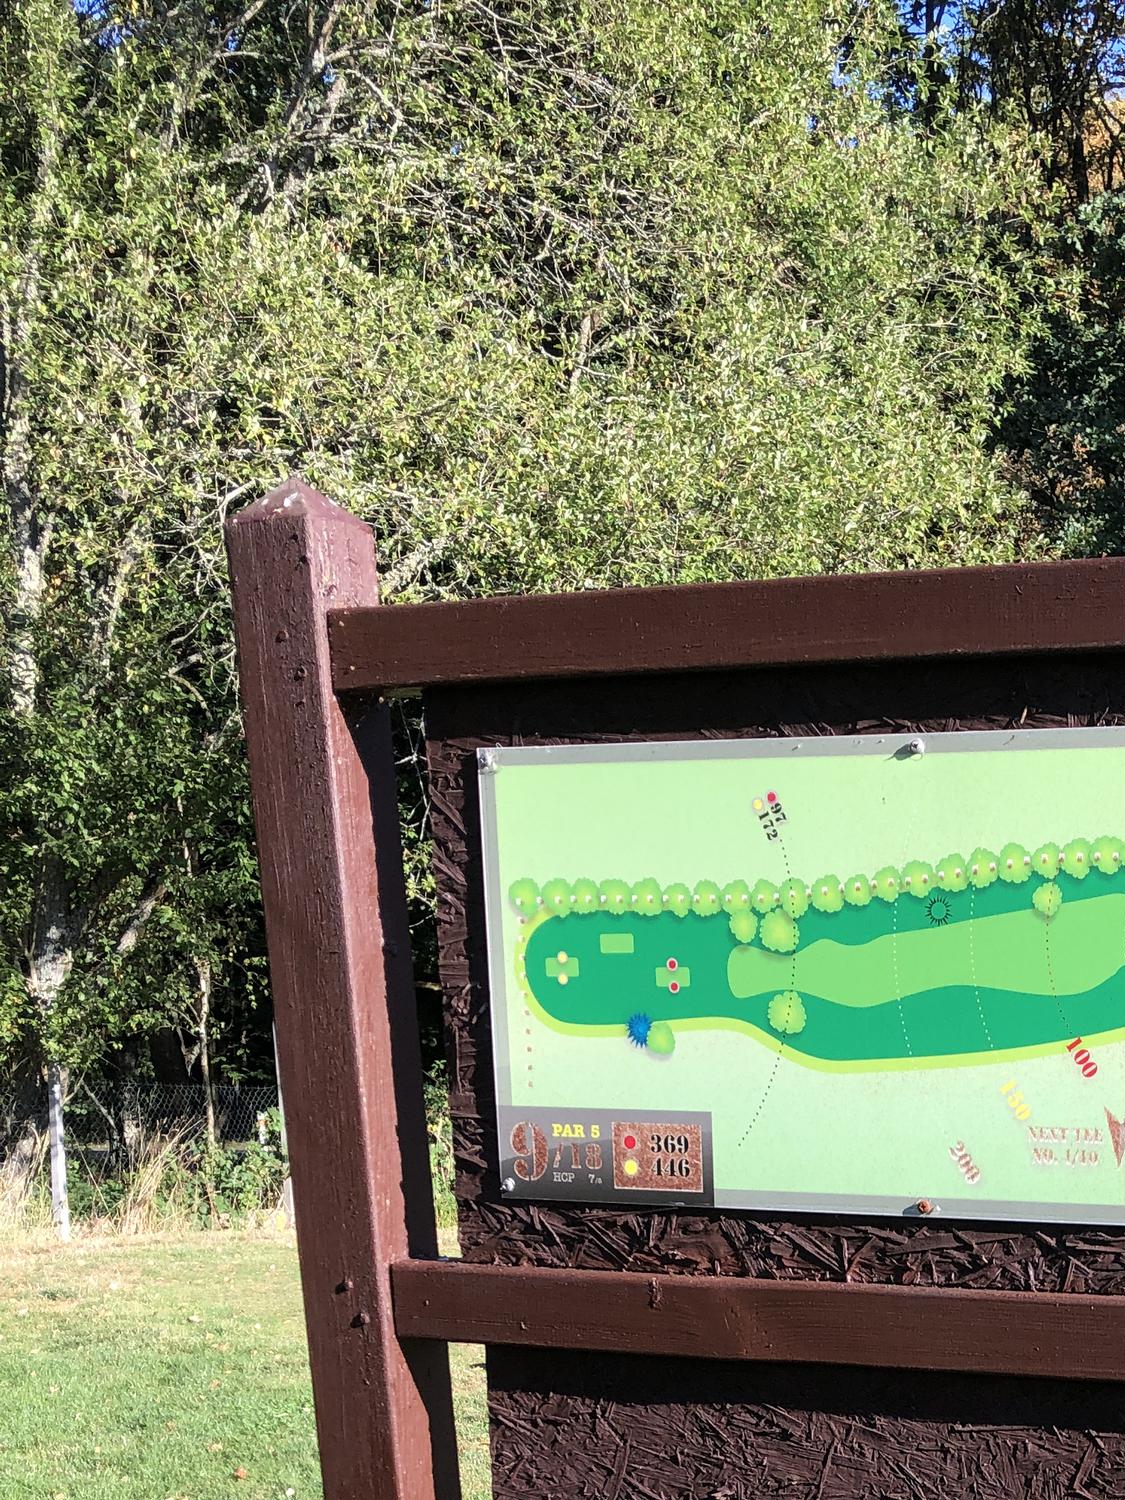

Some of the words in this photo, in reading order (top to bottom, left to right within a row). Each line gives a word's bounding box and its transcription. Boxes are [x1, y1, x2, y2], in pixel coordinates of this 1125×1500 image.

[770, 802, 787, 822] 97
[758, 810, 778, 841] 172
[1066, 1036, 1098, 1078] 100
[1000, 1079, 1031, 1121] 150
[552, 1123, 585, 1137] PAR
[591, 1125, 600, 1138] 5
[1029, 1126, 1068, 1141] NEXT
[1075, 1127, 1103, 1142] TEE
[510, 1121, 549, 1181] 9
[650, 1134, 689, 1154] 369
[553, 1171, 575, 1183] HCP
[651, 1158, 690, 1177] 446
